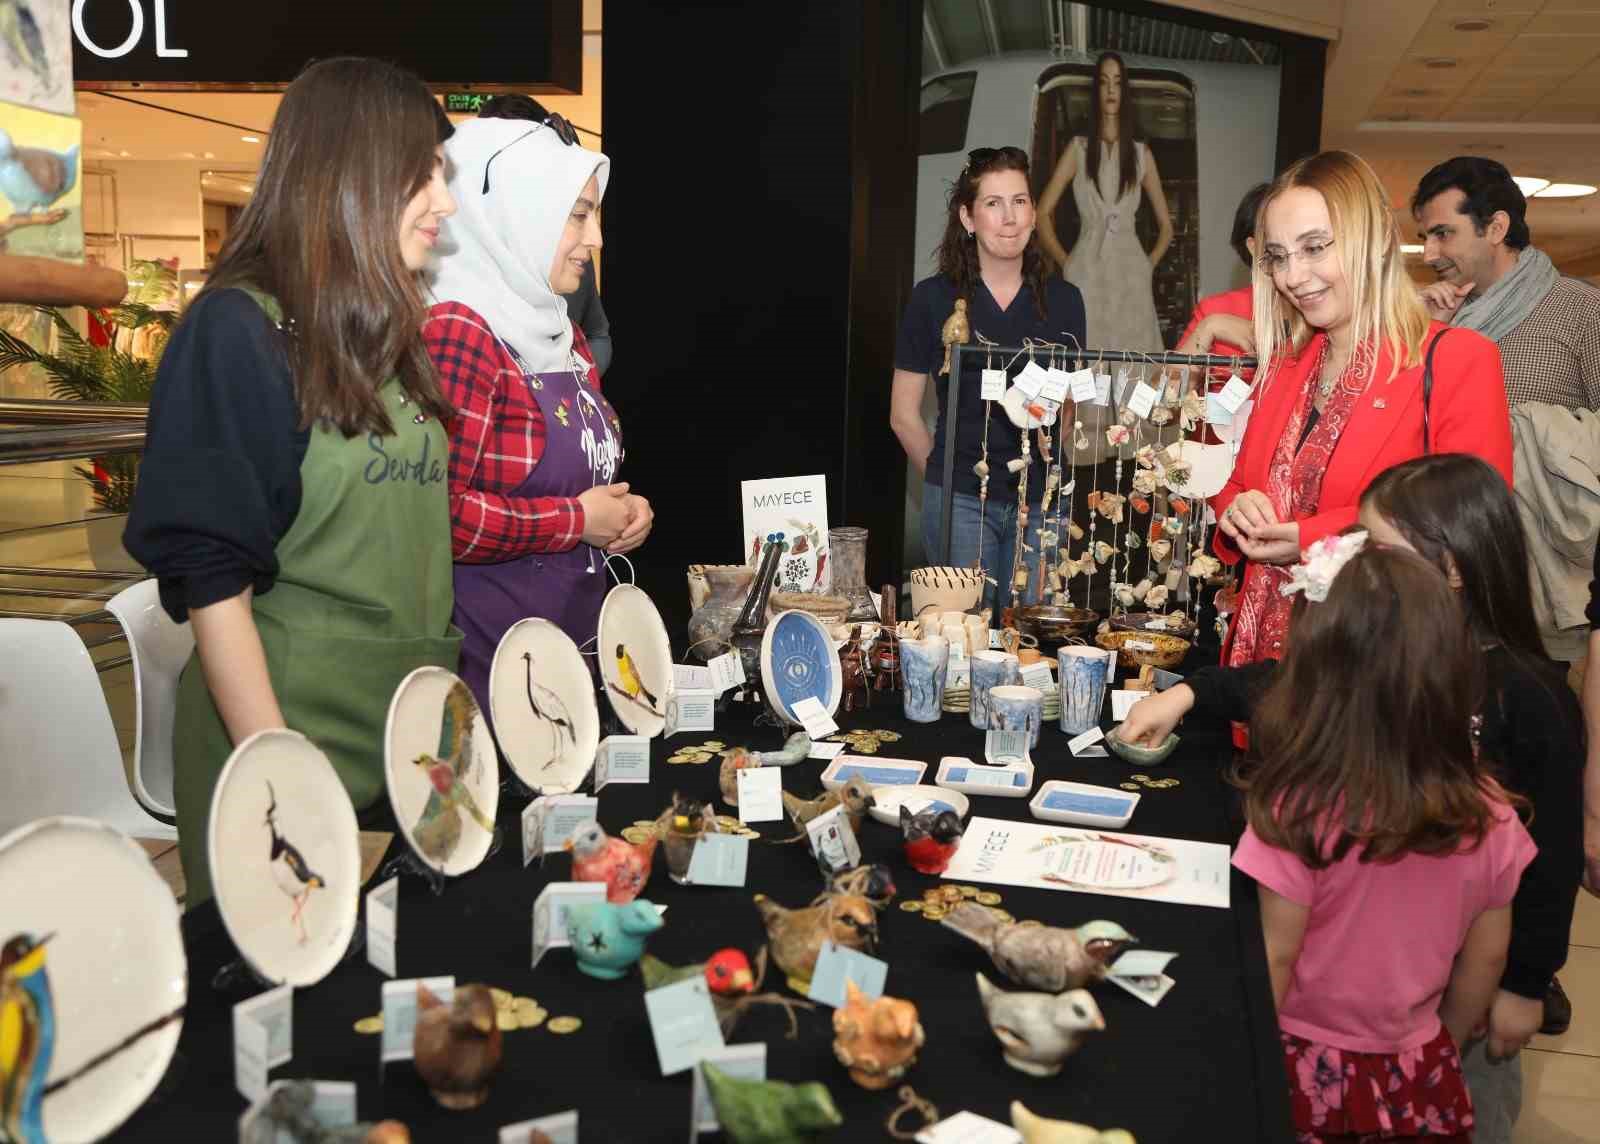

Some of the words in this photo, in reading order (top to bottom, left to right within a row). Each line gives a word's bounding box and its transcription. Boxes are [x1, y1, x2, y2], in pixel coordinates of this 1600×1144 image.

[72, 0, 188, 58] OL
[364, 431, 445, 485] Sevda
[753, 491, 812, 509] MAYECE
